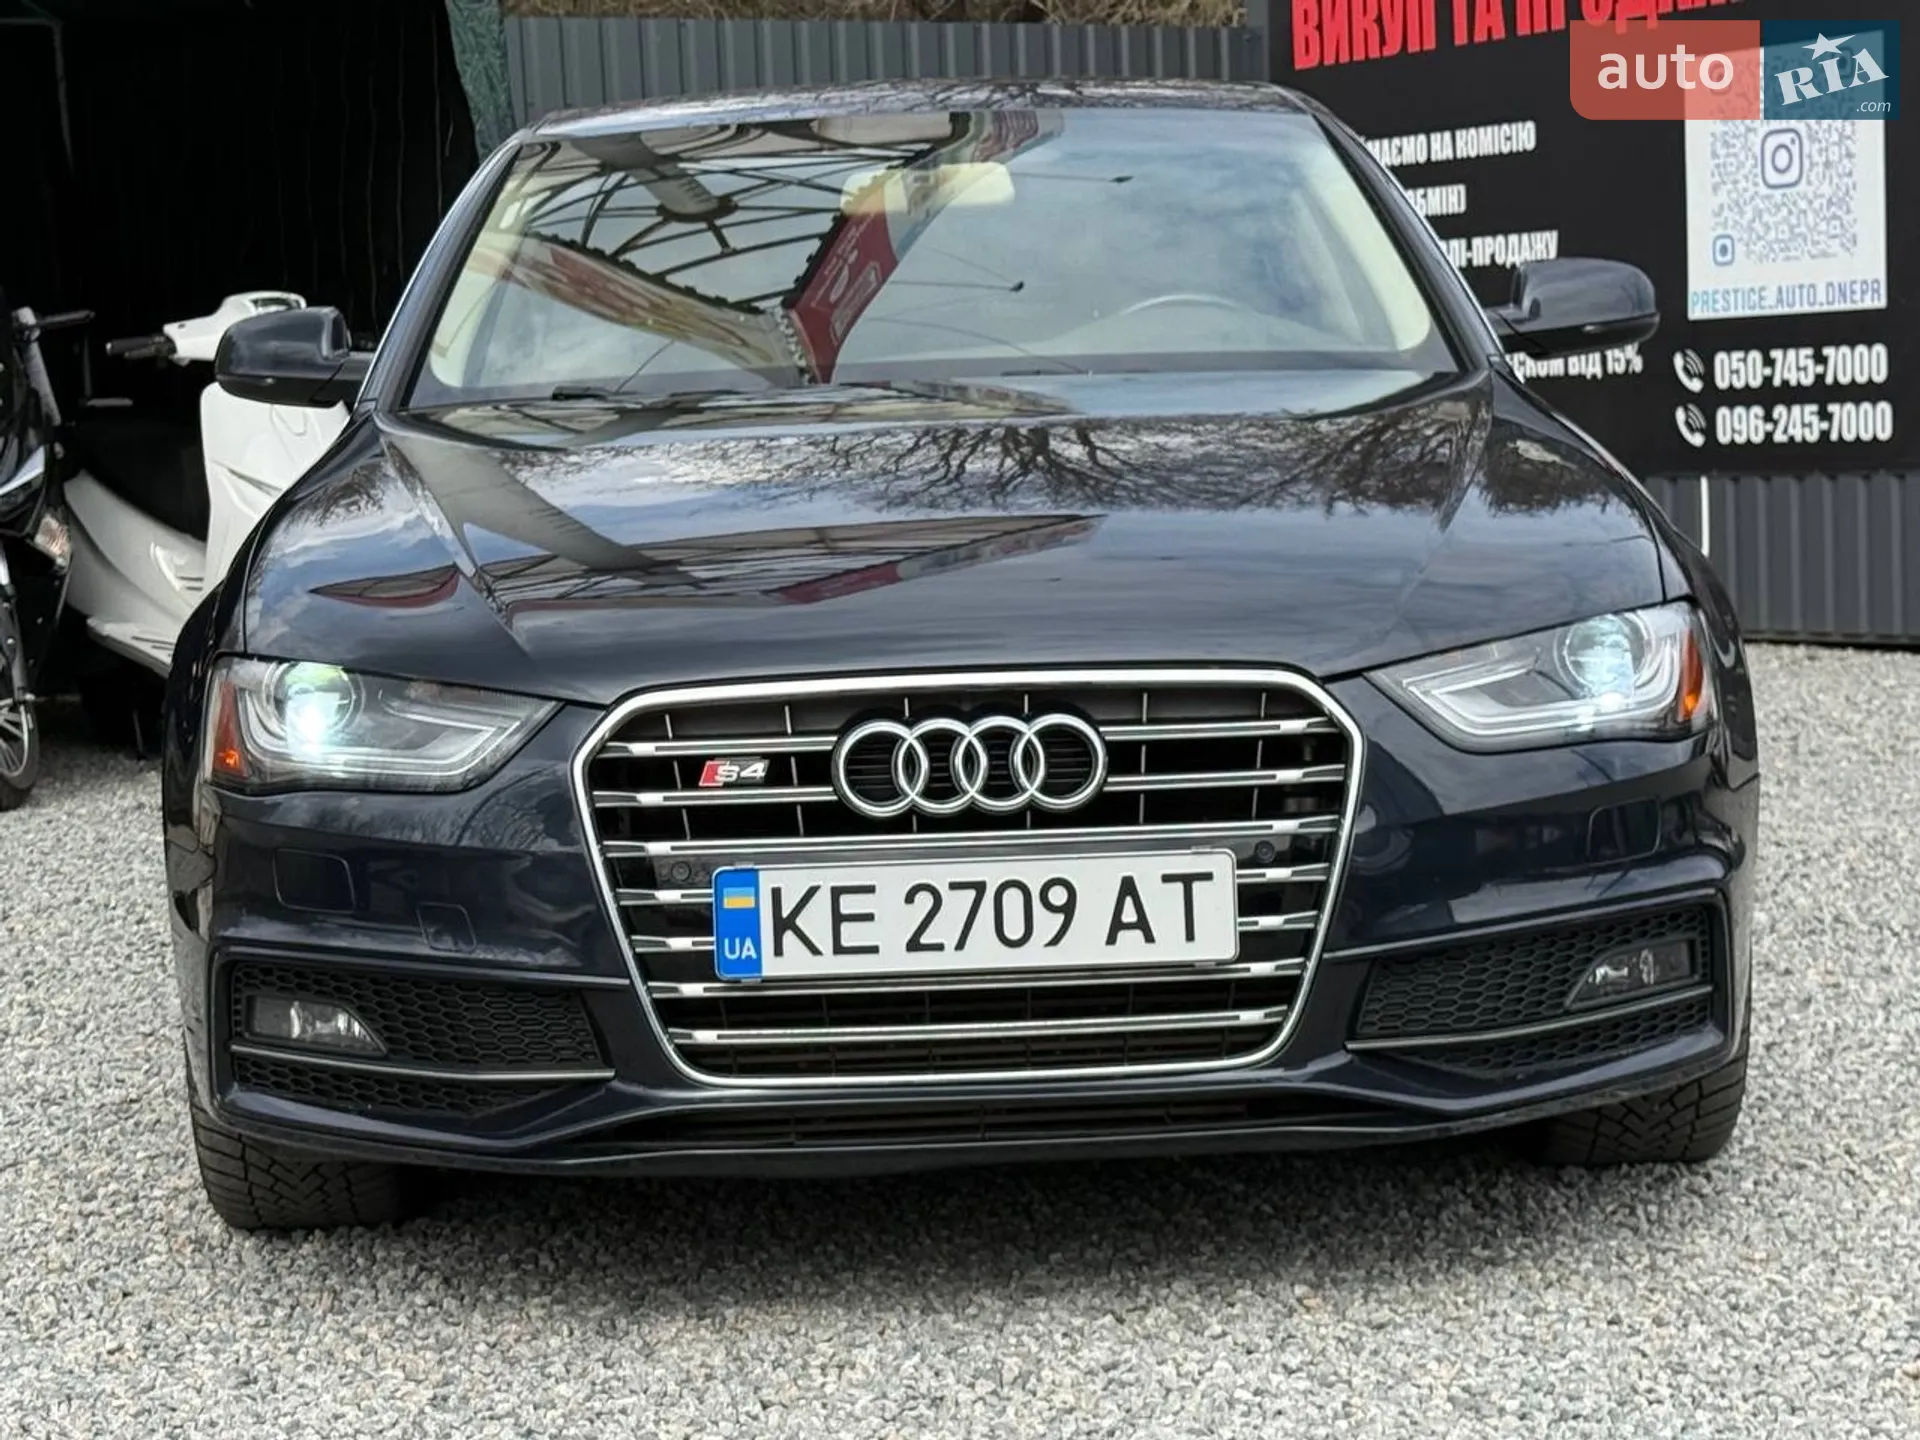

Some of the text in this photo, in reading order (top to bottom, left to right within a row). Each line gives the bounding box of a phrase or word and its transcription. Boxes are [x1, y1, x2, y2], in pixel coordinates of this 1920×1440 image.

[1291, 0, 1437, 71] ВИКУП
[1430, 130, 1454, 162] НА
[1455, 120, 1537, 159] КОМІСІЮ
[1713, 342, 1889, 390] 050-745-7000
[1715, 400, 1894, 446] 096-245-7000
[713, 761, 766, 782] S4
[770, 871, 1214, 958] KE 2709 AT
[724, 938, 758, 961] UA
